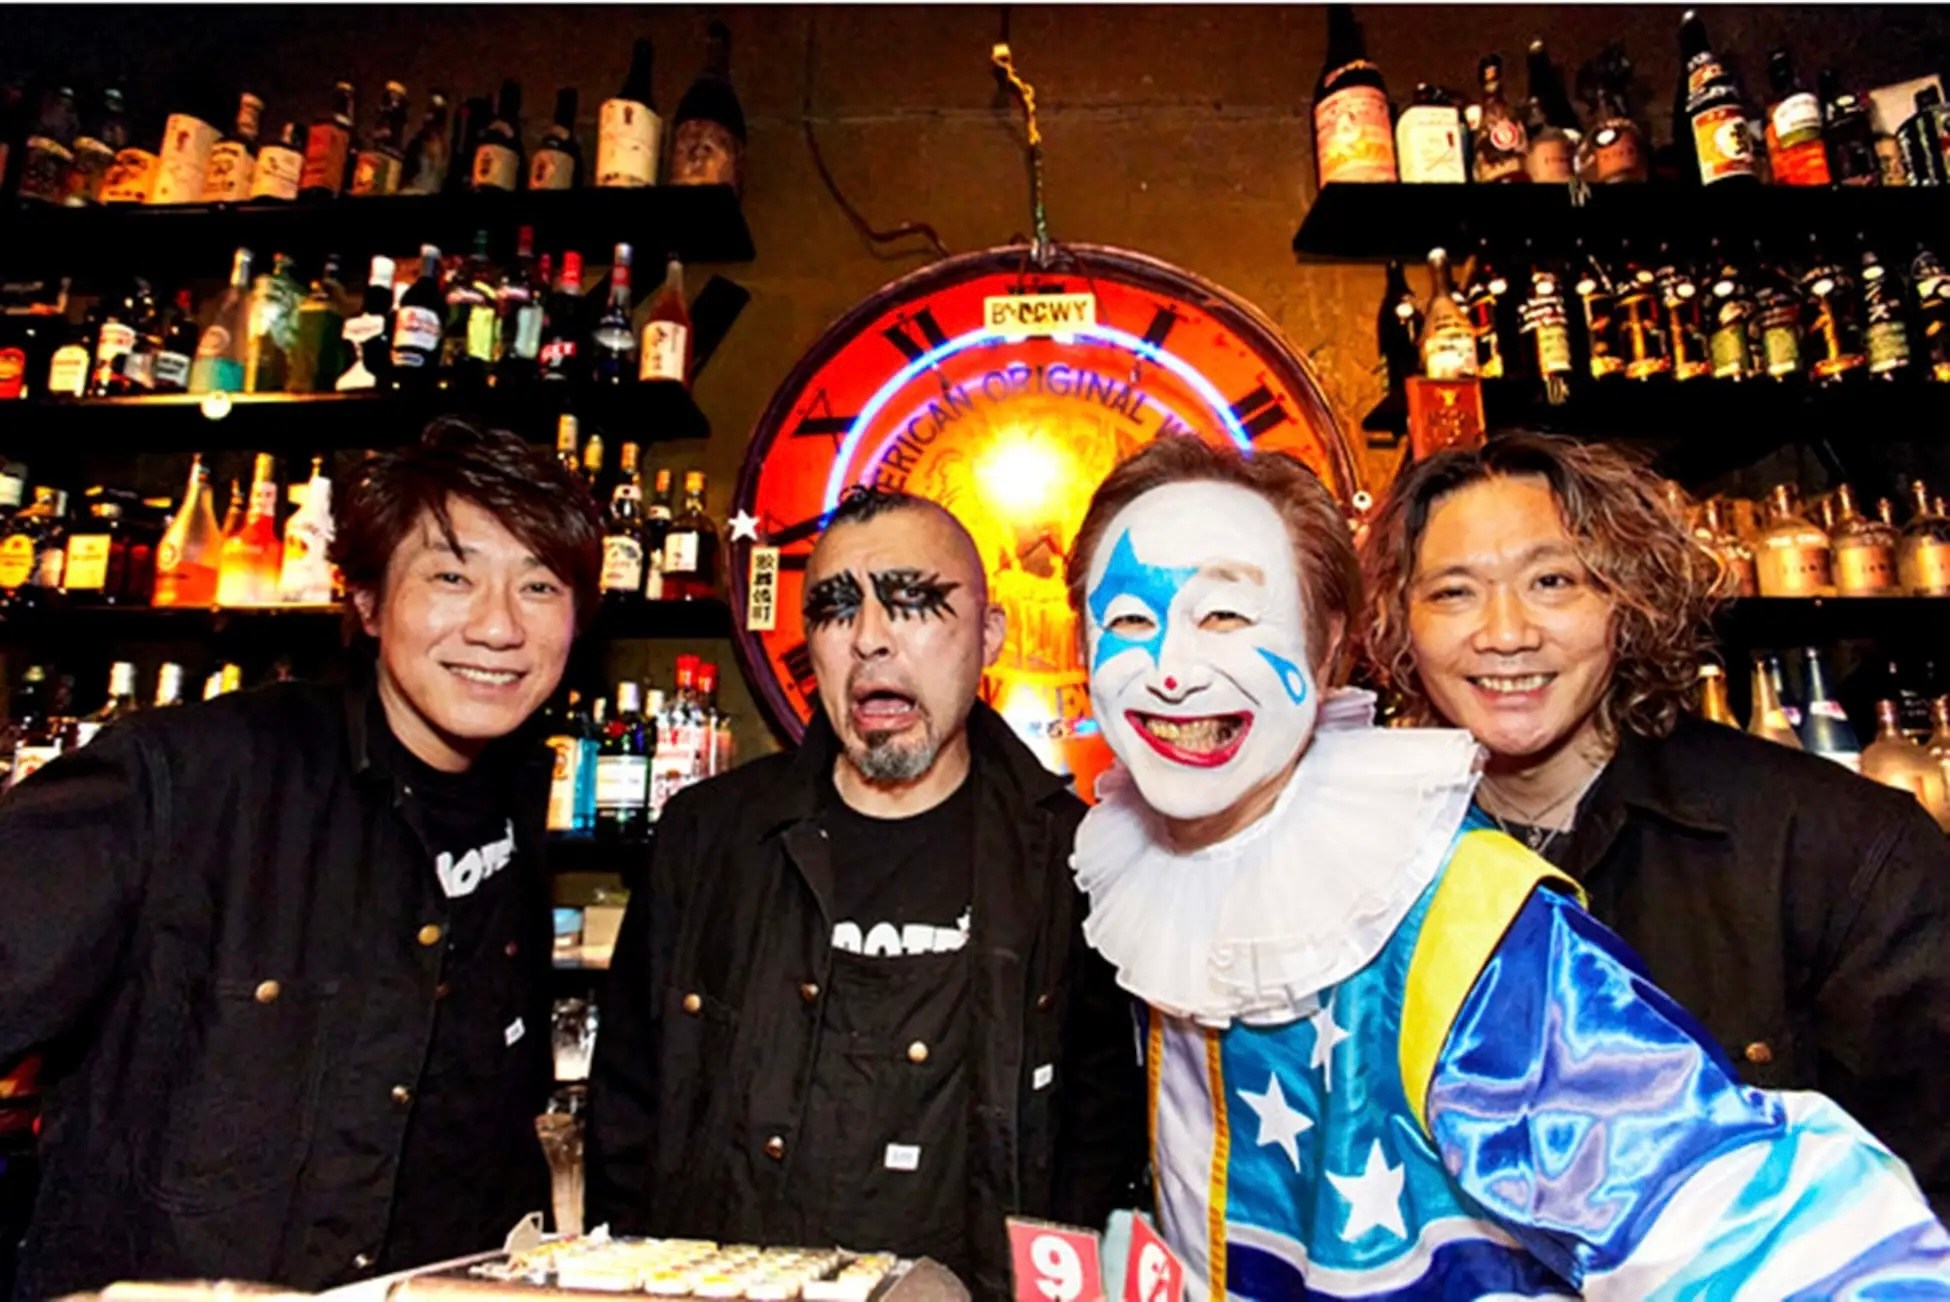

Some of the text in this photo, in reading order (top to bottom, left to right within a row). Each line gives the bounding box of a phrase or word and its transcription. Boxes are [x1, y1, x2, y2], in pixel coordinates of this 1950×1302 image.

[872, 361, 1147, 492] ERICAN ORIGINAL
[1030, 1234, 1084, 1302] 9
